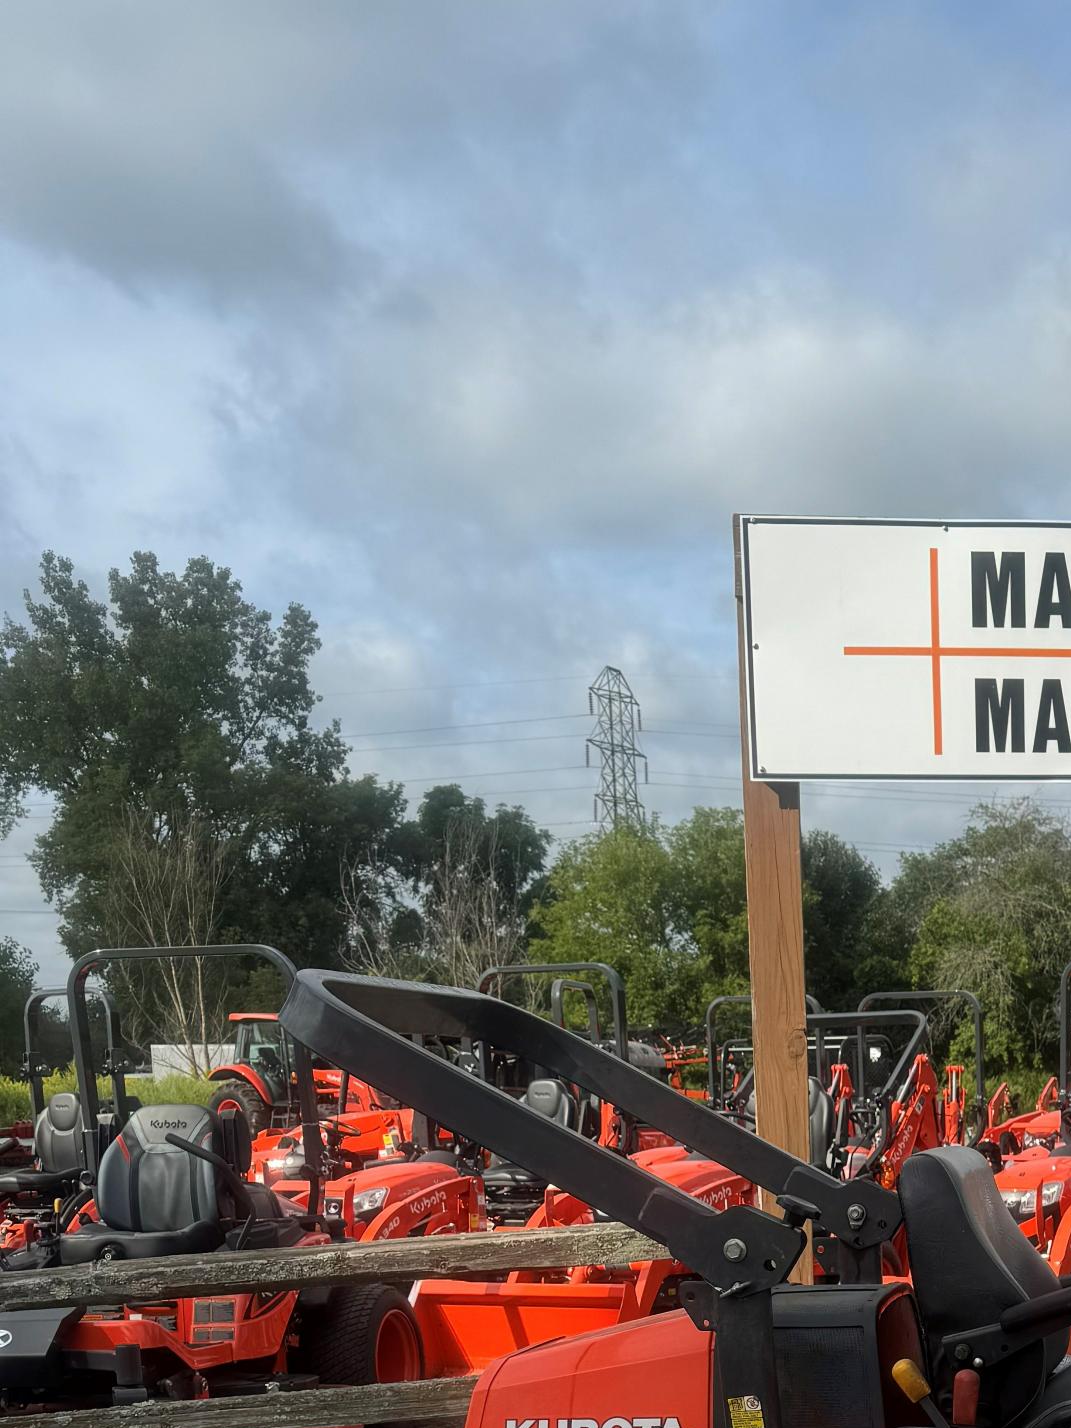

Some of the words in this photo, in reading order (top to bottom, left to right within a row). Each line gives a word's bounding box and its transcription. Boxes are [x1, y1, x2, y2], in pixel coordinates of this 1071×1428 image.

[150, 1119, 187, 1129] Kubota
[892, 1125, 913, 1163] Kubota
[409, 1190, 447, 1214] Kubota
